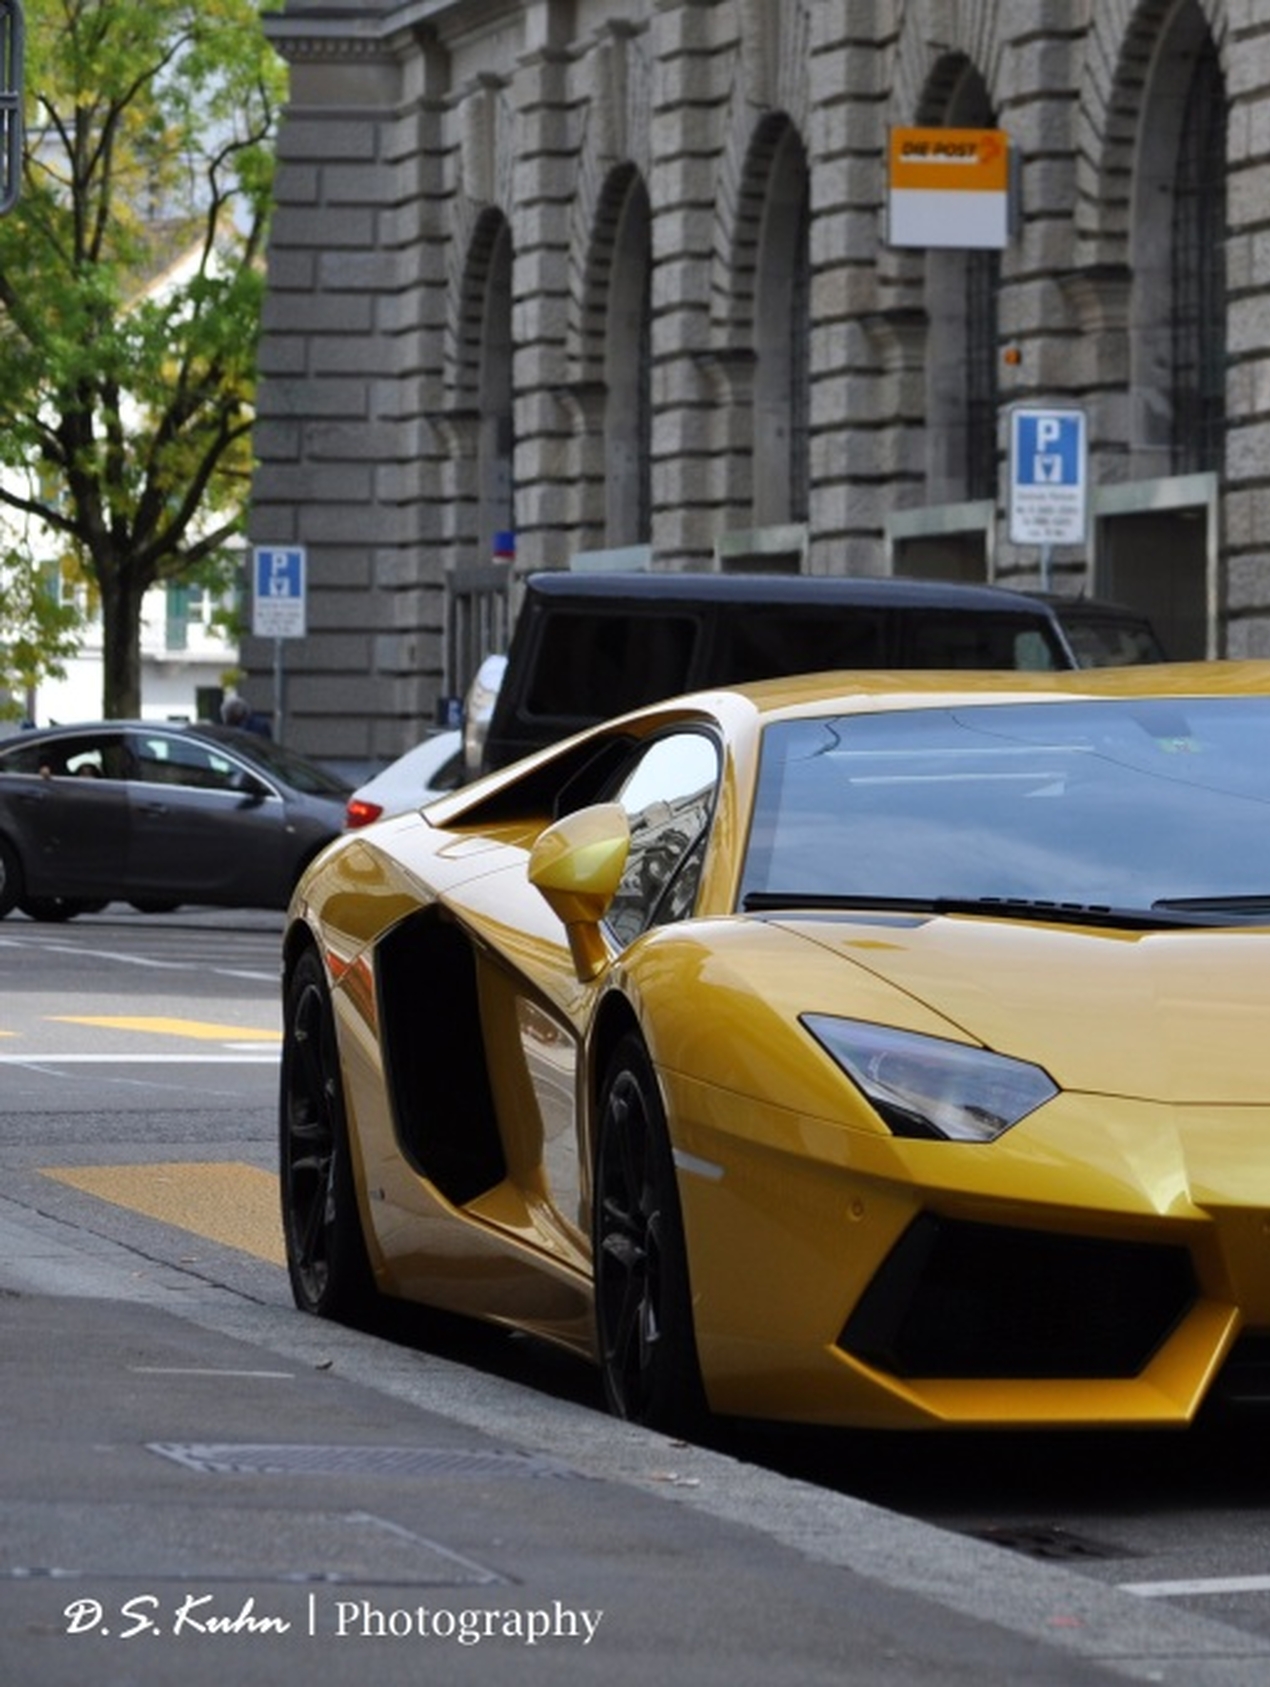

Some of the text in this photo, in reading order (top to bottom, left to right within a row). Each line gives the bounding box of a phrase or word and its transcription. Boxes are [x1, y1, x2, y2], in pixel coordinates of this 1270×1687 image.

[901, 142, 978, 158] DIE POST
[1036, 419, 1060, 452] P
[271, 551, 288, 576] P
